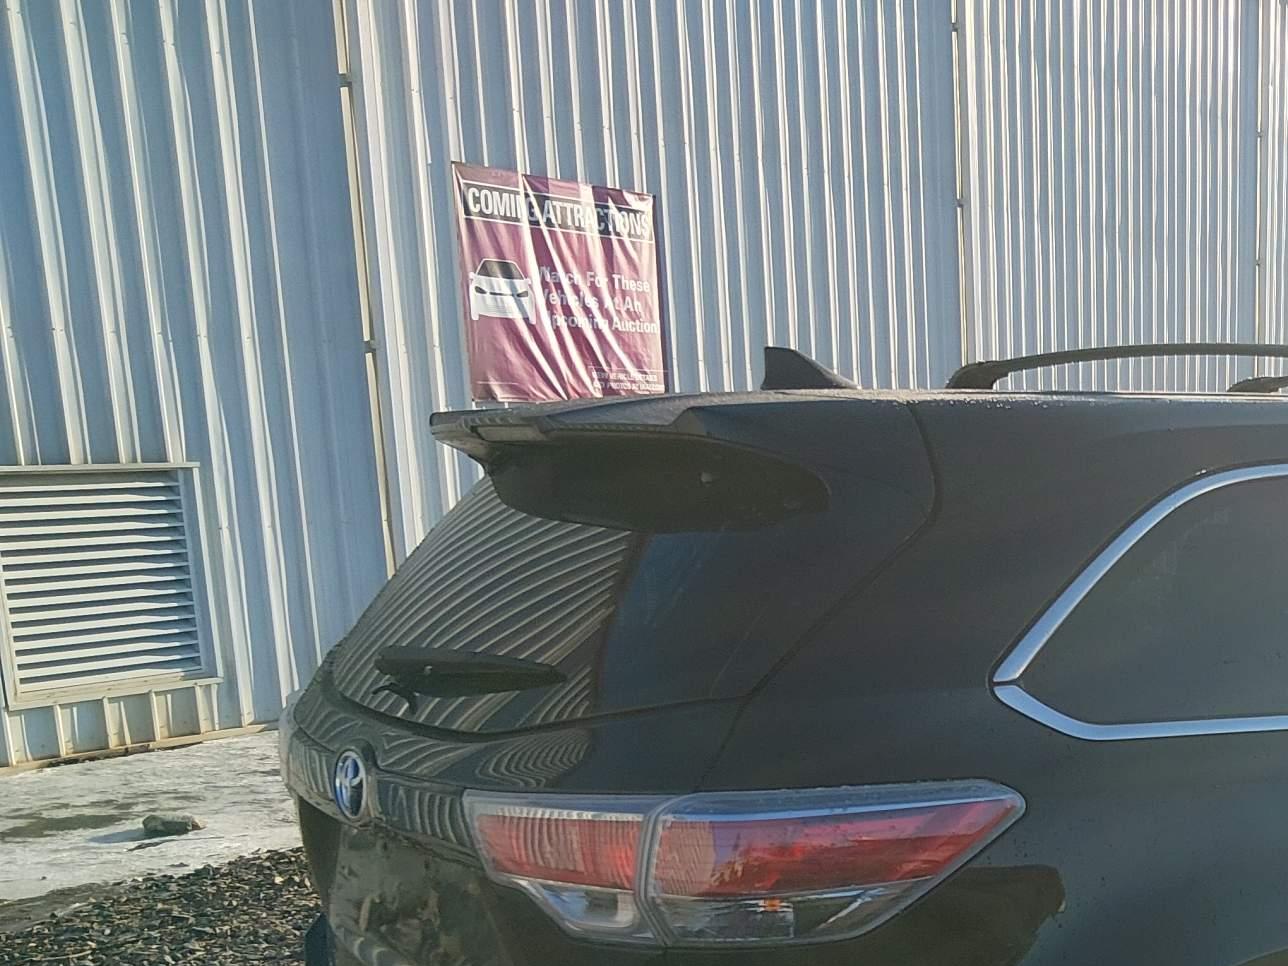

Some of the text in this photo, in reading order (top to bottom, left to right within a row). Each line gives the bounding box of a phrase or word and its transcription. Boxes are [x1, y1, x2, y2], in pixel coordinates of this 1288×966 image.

[543, 200, 649, 239] ATTRACTIONS
[540, 266, 582, 286] Wach
[612, 273, 650, 293] These
[541, 289, 599, 309] Vehcles
[546, 311, 658, 336] pcoming Auction
